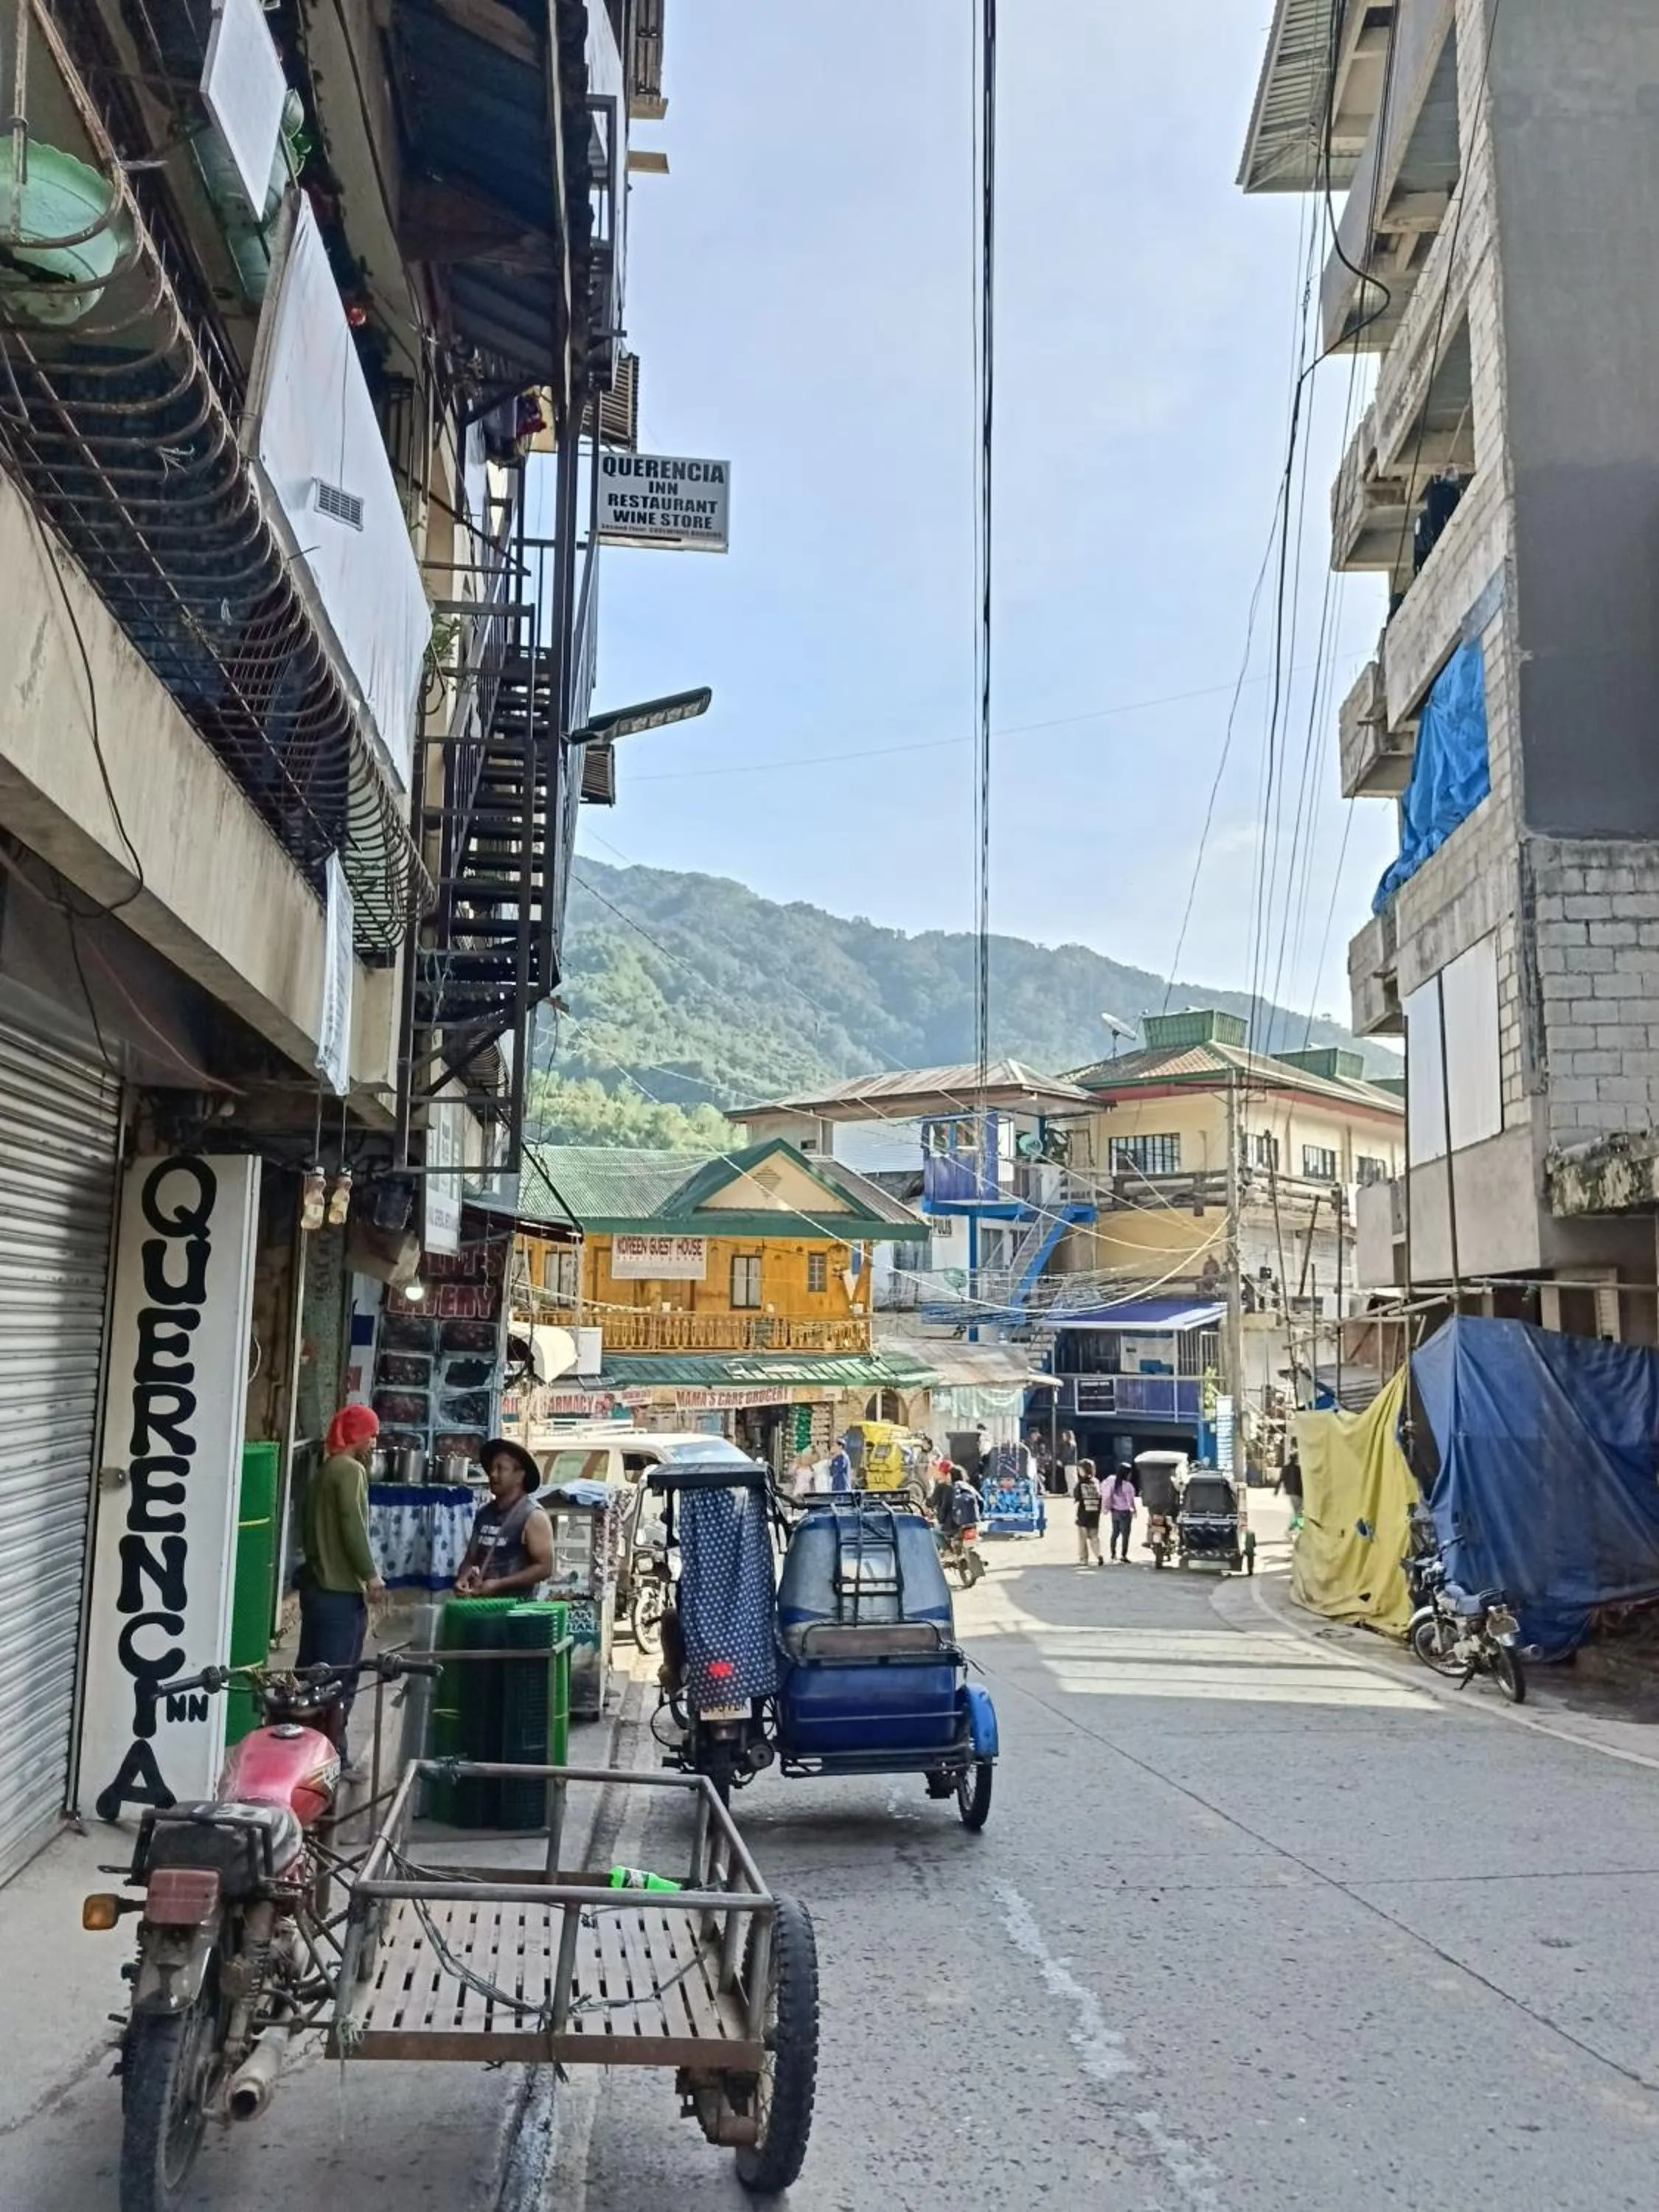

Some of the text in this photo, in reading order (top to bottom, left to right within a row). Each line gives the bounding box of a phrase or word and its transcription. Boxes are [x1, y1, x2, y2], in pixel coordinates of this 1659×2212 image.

[602, 456, 725, 484] QUERENCIA
[648, 481, 678, 495] INN
[608, 493, 717, 514] RESTAURANT
[613, 509, 714, 529] WINE STORE
[95, 1155, 218, 1820] QUERENCIA
